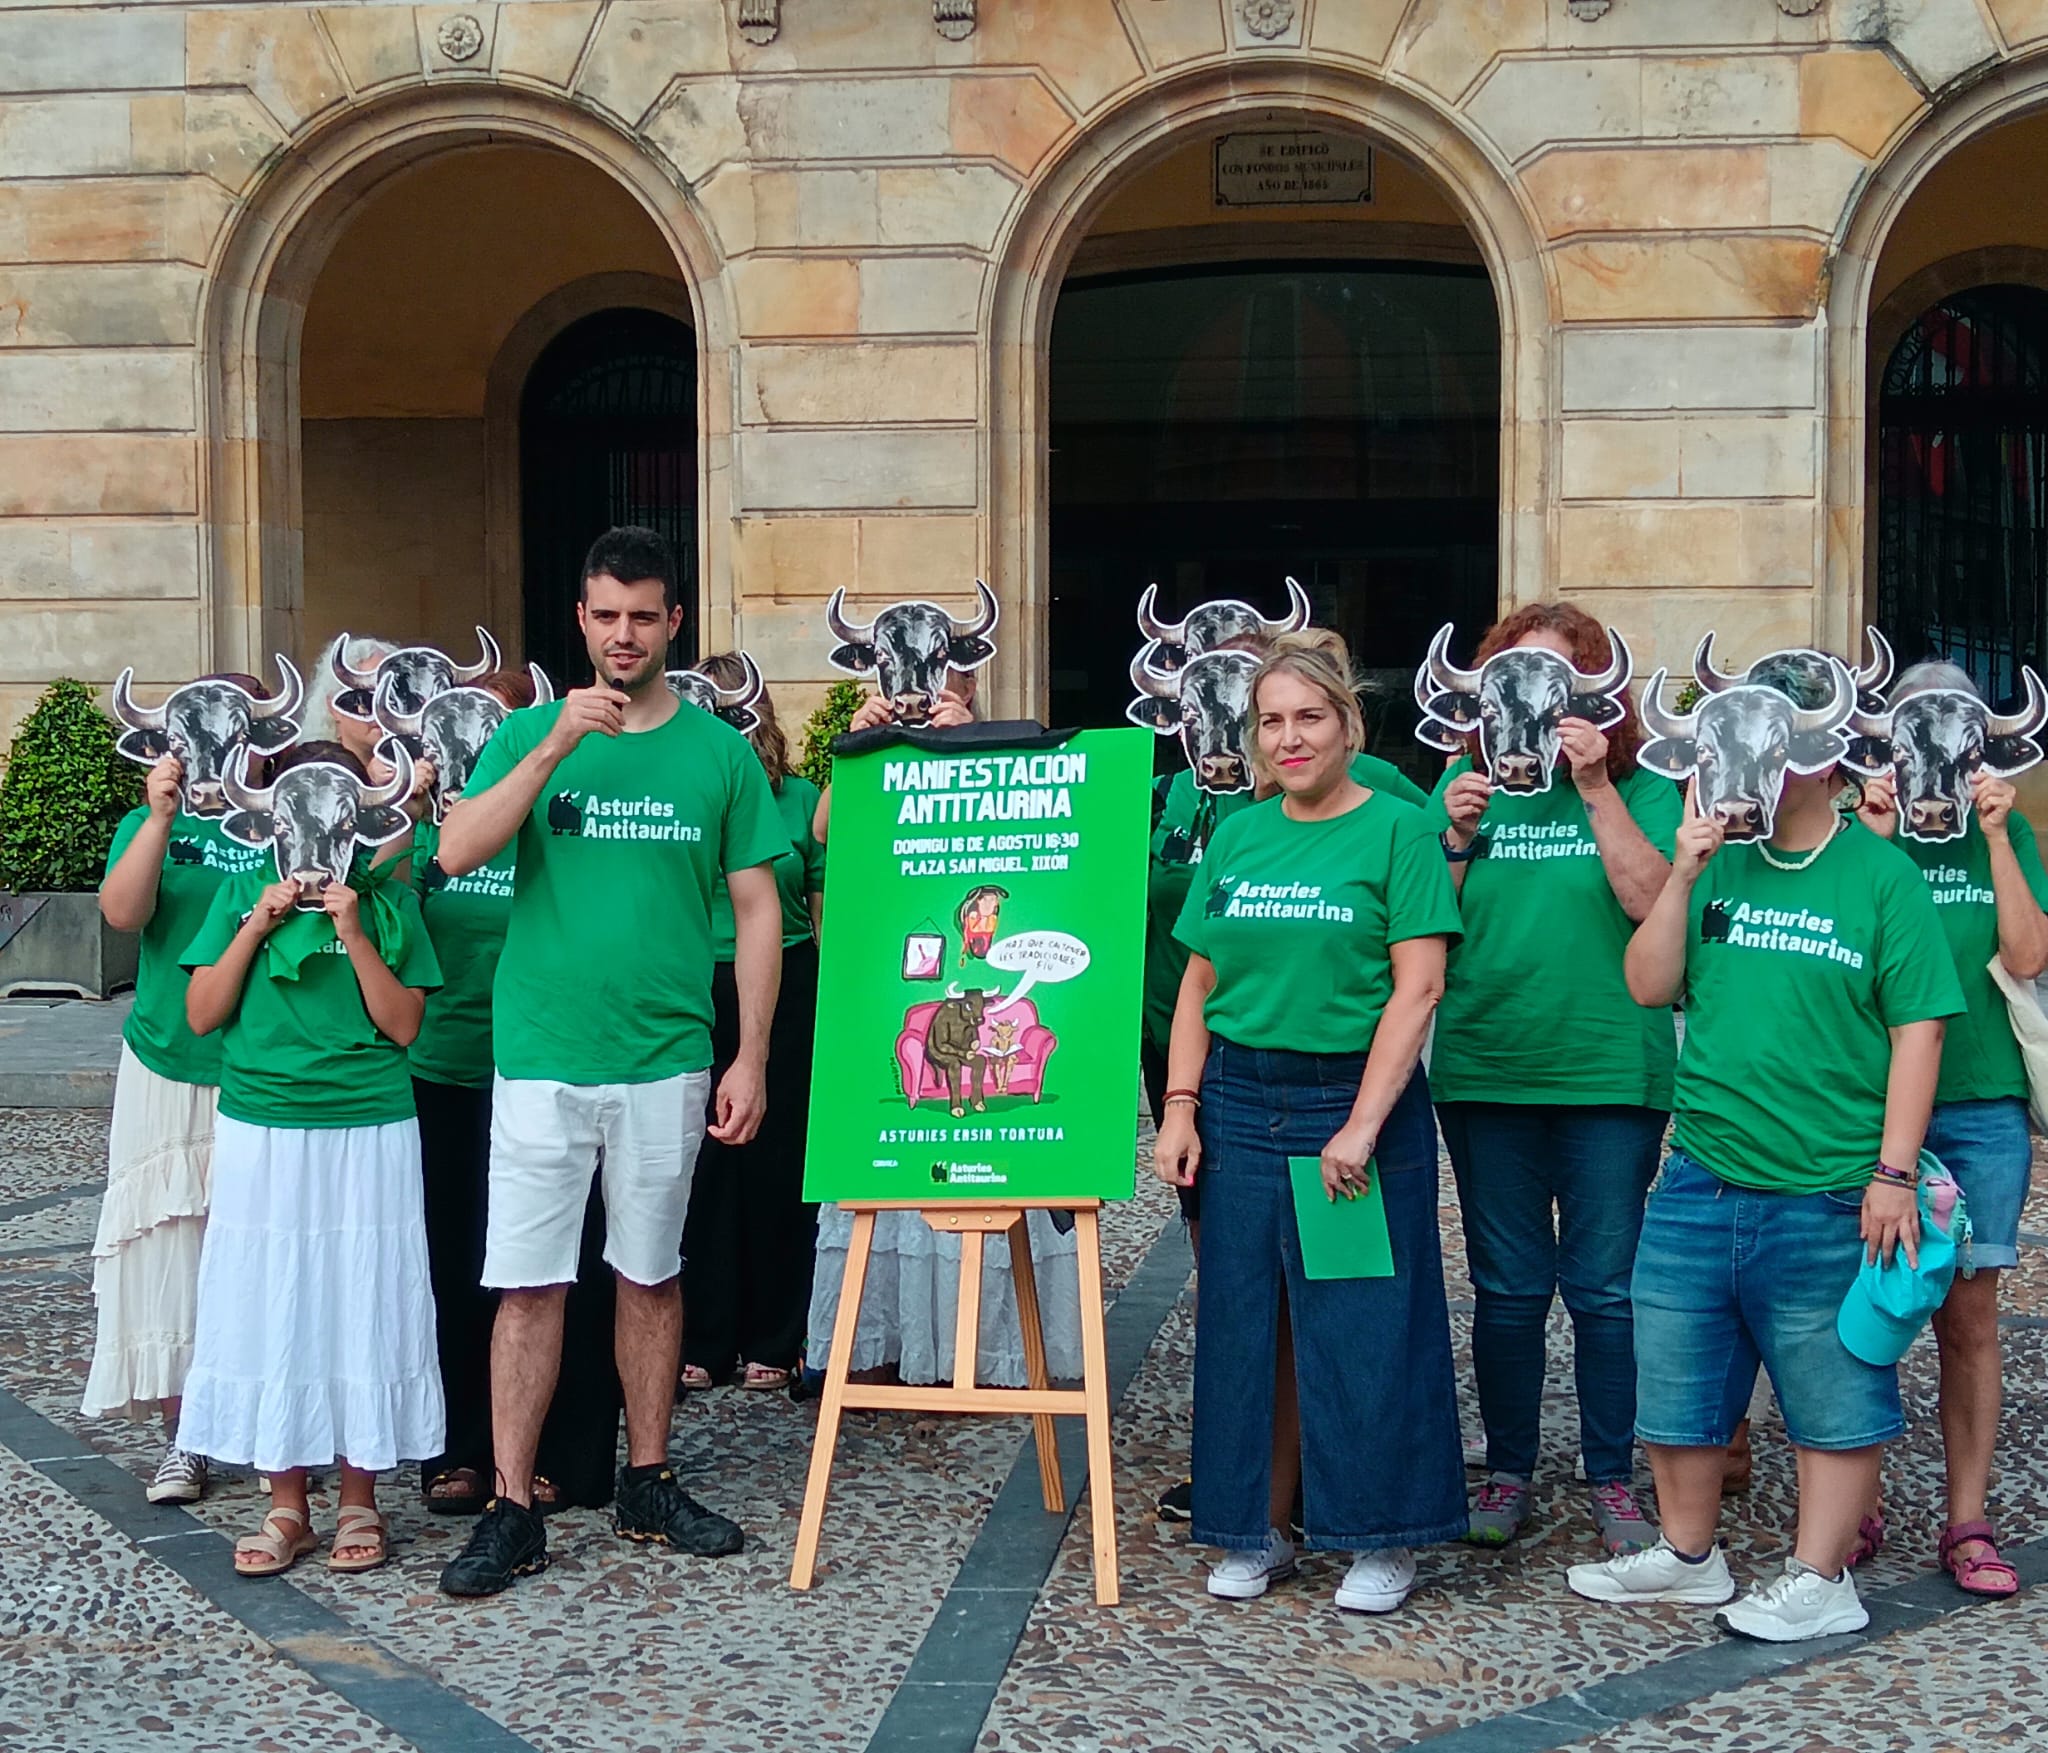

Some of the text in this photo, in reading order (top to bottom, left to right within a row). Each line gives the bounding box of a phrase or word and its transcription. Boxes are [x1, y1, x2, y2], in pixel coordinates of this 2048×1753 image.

[1284, 179, 1298, 190] DE
[883, 742, 1087, 792] MANIFESTACIÓN
[584, 795, 674, 817] Asturies
[897, 788, 1072, 825] ANTITAURINA
[582, 817, 702, 842] Antitaurina
[1492, 821, 1578, 841] Asturies
[893, 838, 949, 855] DOMINGU
[951, 837, 965, 853] 16
[967, 835, 984, 852] DE
[987, 834, 1042, 852] AGOSTU
[901, 859, 946, 876] PLAZA
[949, 857, 976, 874] SAN
[1031, 848, 1069, 871] XIXÓN
[443, 877, 515, 897] Antita
[1233, 881, 1321, 900] Asturies
[1225, 898, 1354, 923] Antitaurina
[1732, 902, 1834, 934] Asturies
[1027, 939, 1044, 948] QUE
[1726, 924, 1864, 970] Antitaurina
[879, 1129, 948, 1143] ASTURIES
[1000, 1127, 1064, 1142] TORTURA
[949, 1172, 1007, 1184] Antitaurina
[950, 1162, 992, 1173] Asturies
